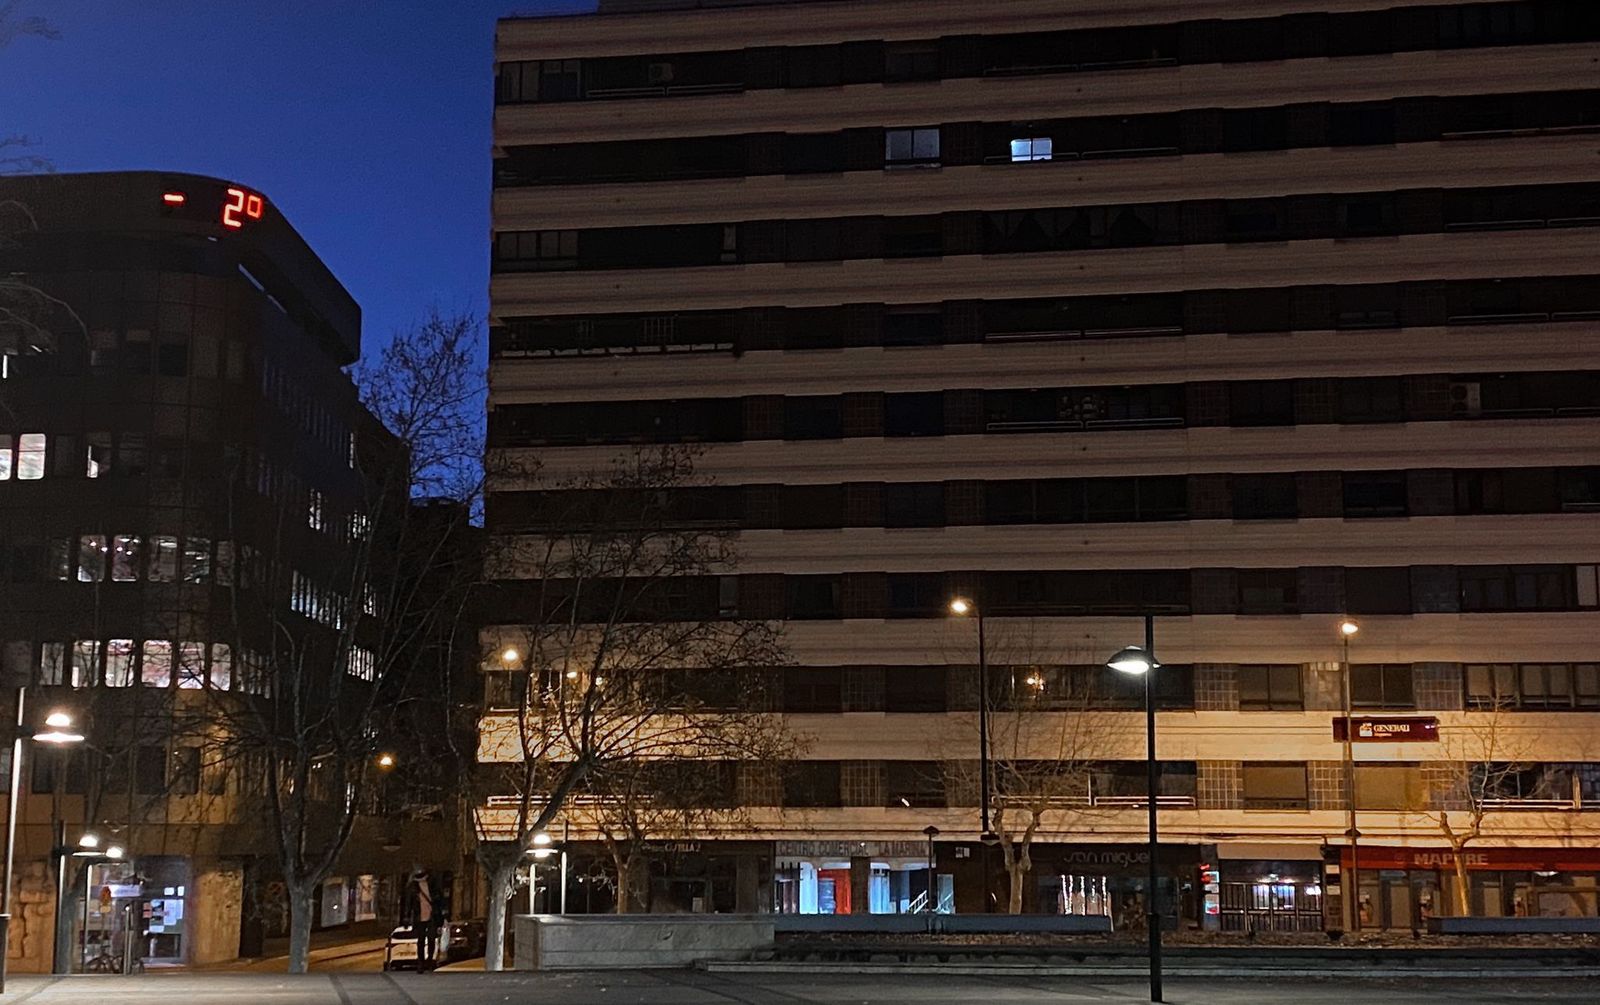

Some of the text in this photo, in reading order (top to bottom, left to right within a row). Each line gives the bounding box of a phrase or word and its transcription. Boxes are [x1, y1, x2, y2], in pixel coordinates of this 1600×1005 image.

[1373, 724, 1410, 733] GENERALI
[779, 841, 814, 856] CENTRO
[819, 841, 869, 856] COMERCIAL
[1064, 852, 1098, 863] san
[1414, 853, 1489, 866] MAPRE
